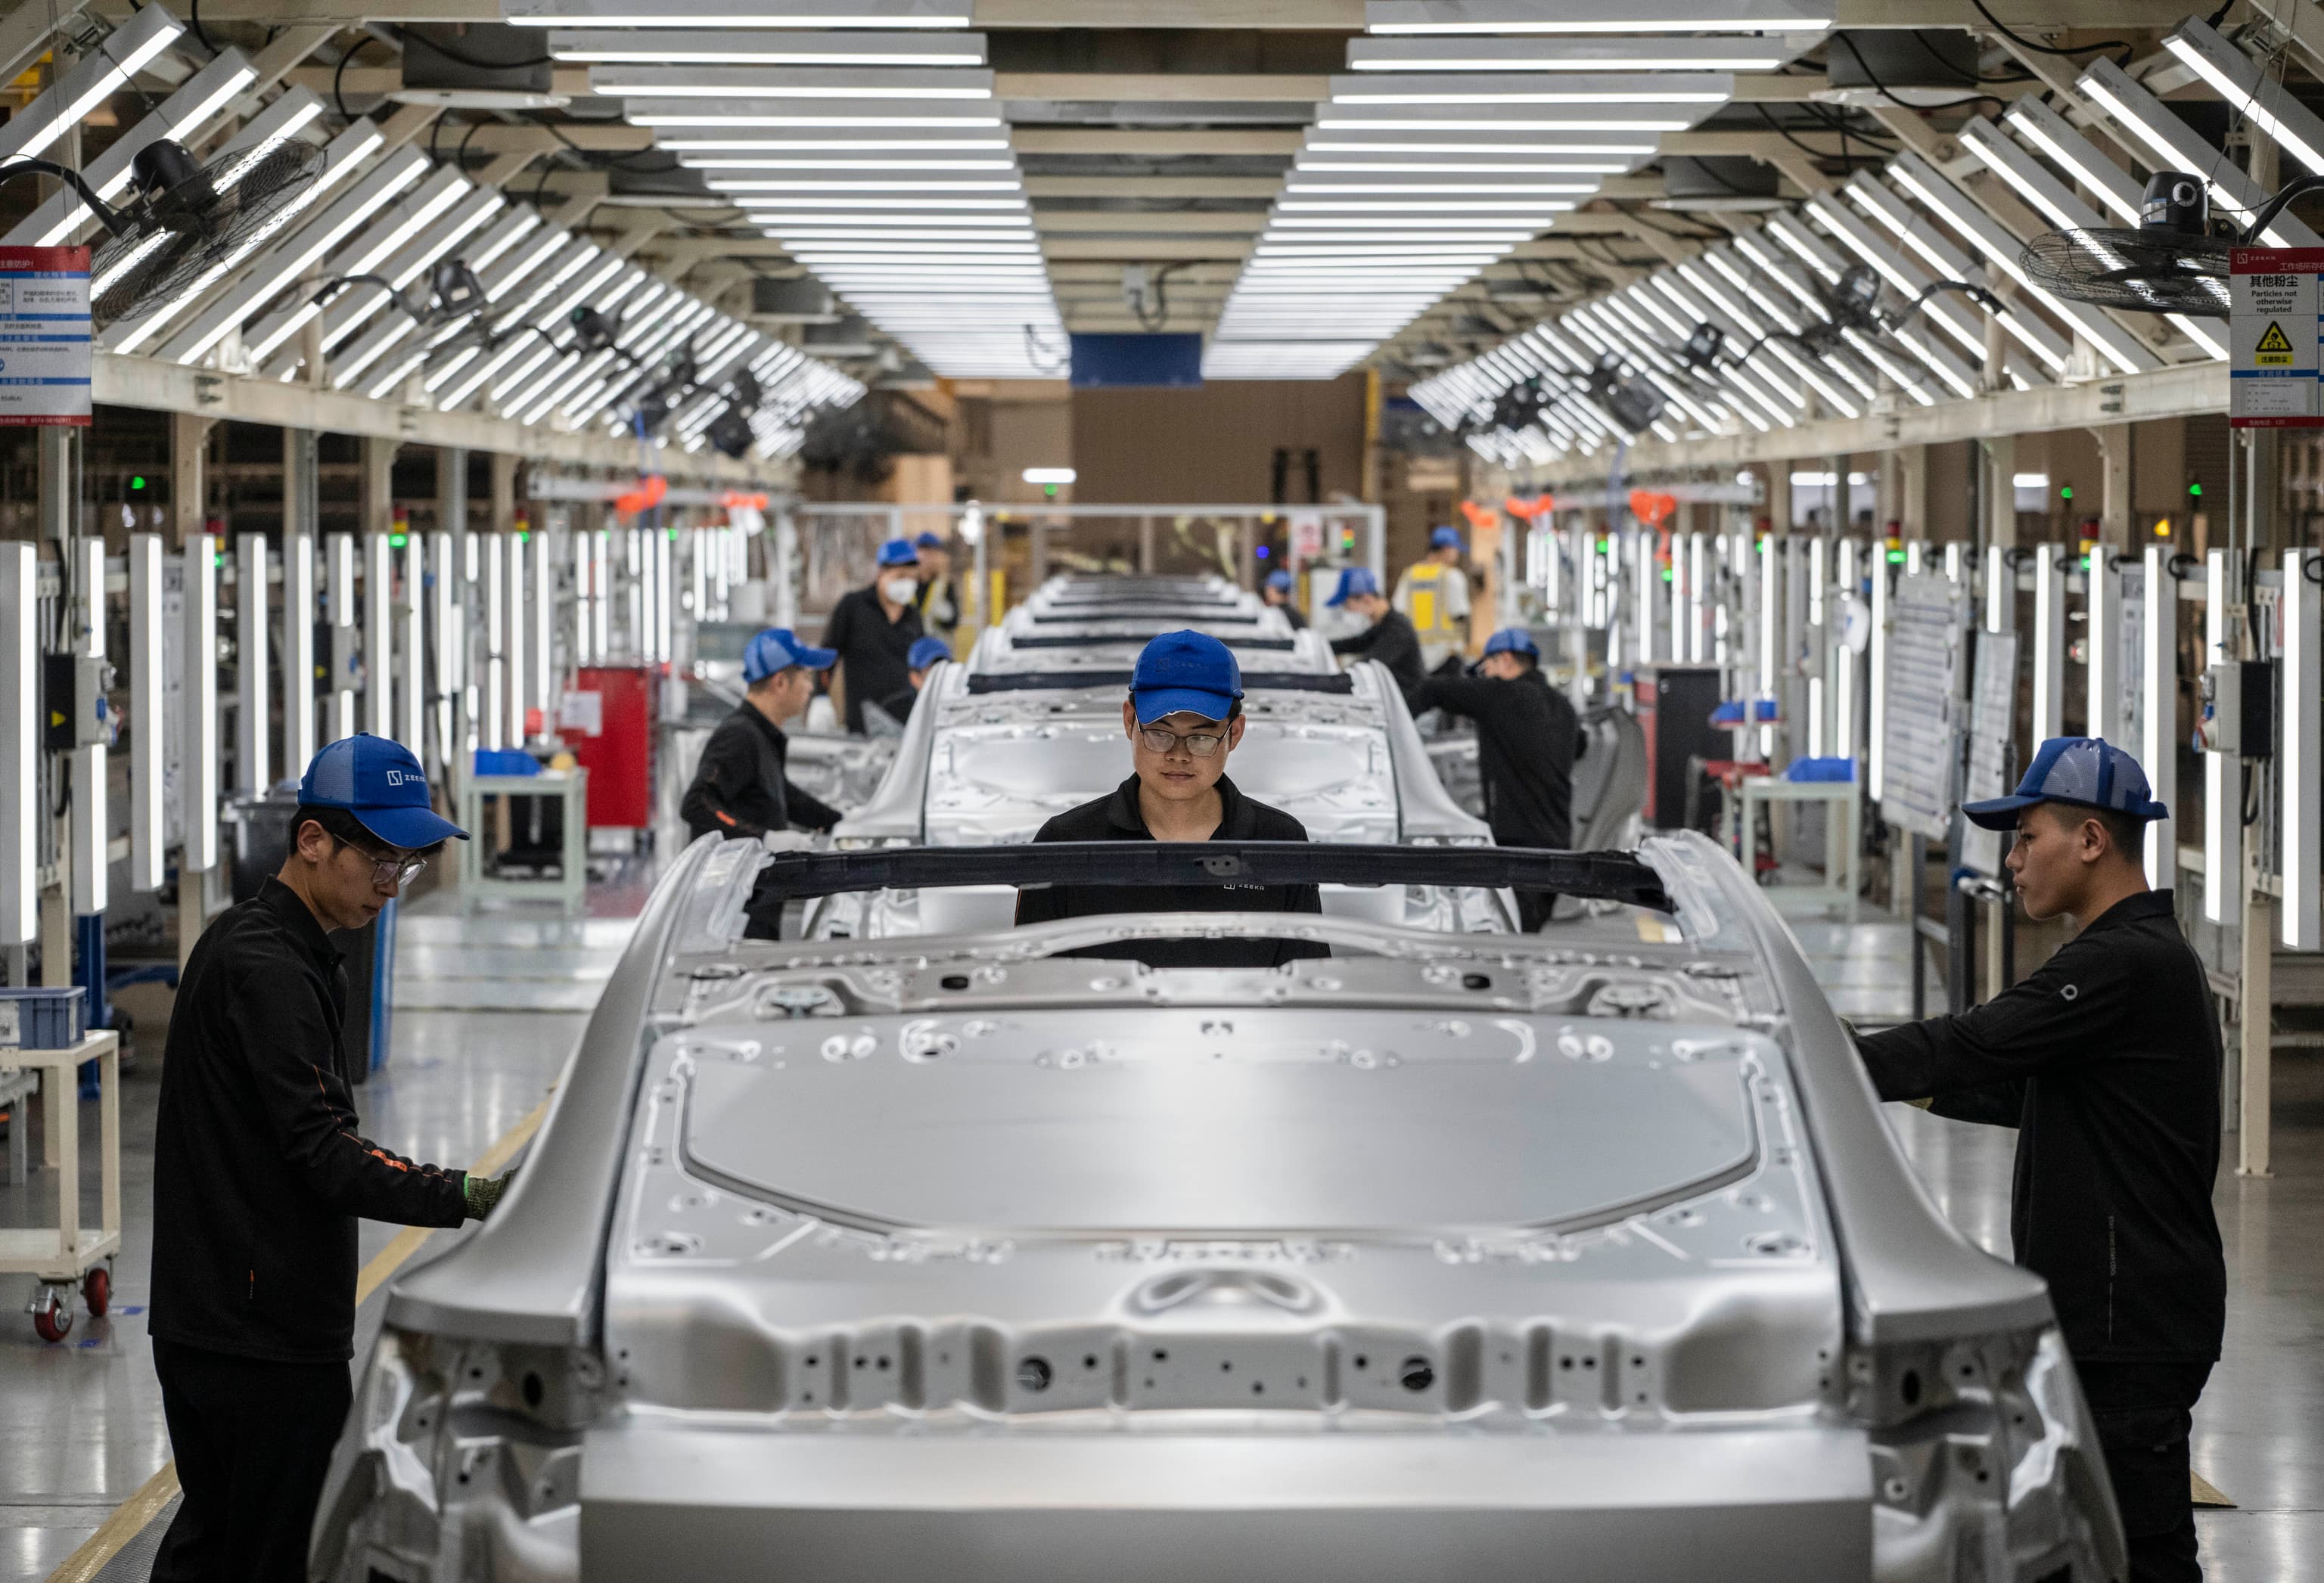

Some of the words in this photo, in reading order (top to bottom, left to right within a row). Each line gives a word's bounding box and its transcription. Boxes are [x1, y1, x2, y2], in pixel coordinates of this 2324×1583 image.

[2249, 275, 2298, 287] 其他粉尘
[2257, 306, 2291, 314] regulated
